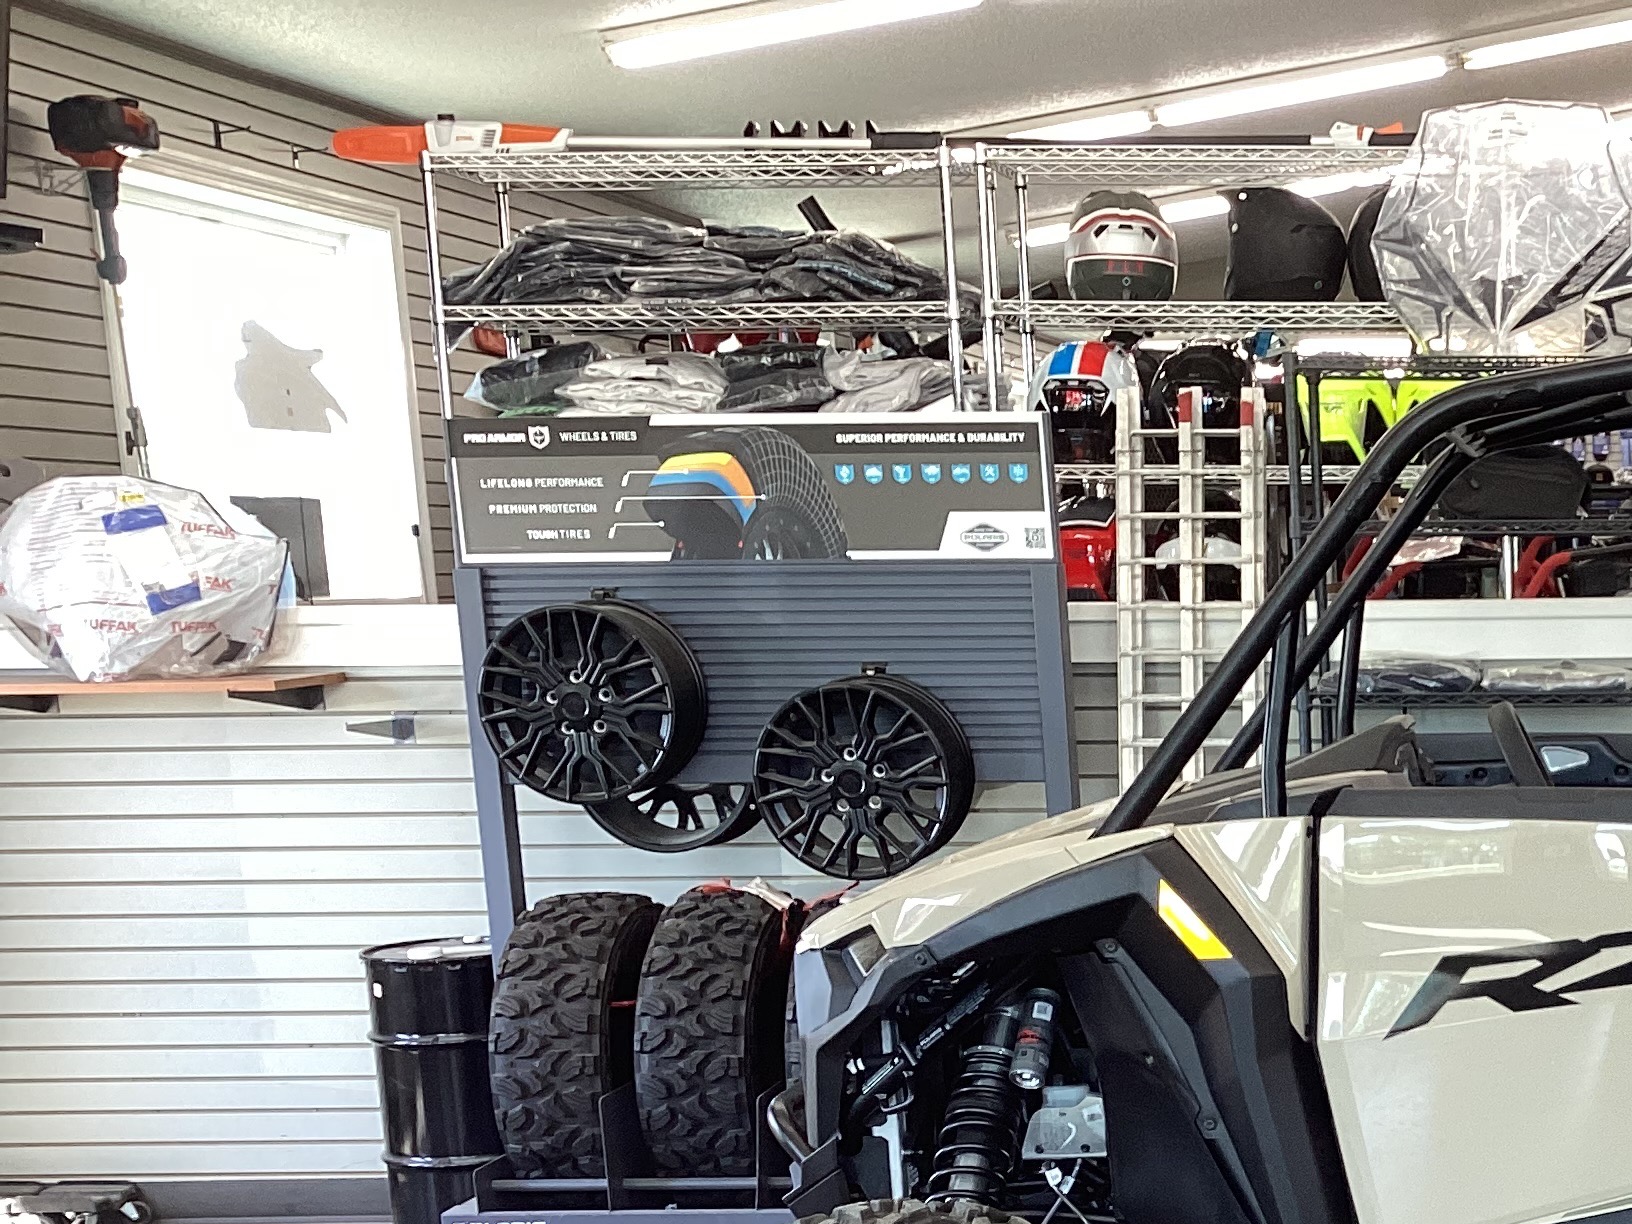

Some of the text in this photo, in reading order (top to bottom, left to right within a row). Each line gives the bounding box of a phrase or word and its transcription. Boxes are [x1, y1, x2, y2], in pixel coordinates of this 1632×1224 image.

[559, 430, 638, 442] WHEELS & TIRES
[835, 431, 1026, 444] SUPERIOR PERFORMANCE & DURABILITY
[480, 476, 604, 489] LIFELONG PERFORMANCE
[488, 502, 598, 515] PREMIUM PROTECTION
[180, 521, 237, 540] TUFFAK
[526, 529, 591, 540] TOUGH TIRES
[88, 618, 138, 632] UFFAK
